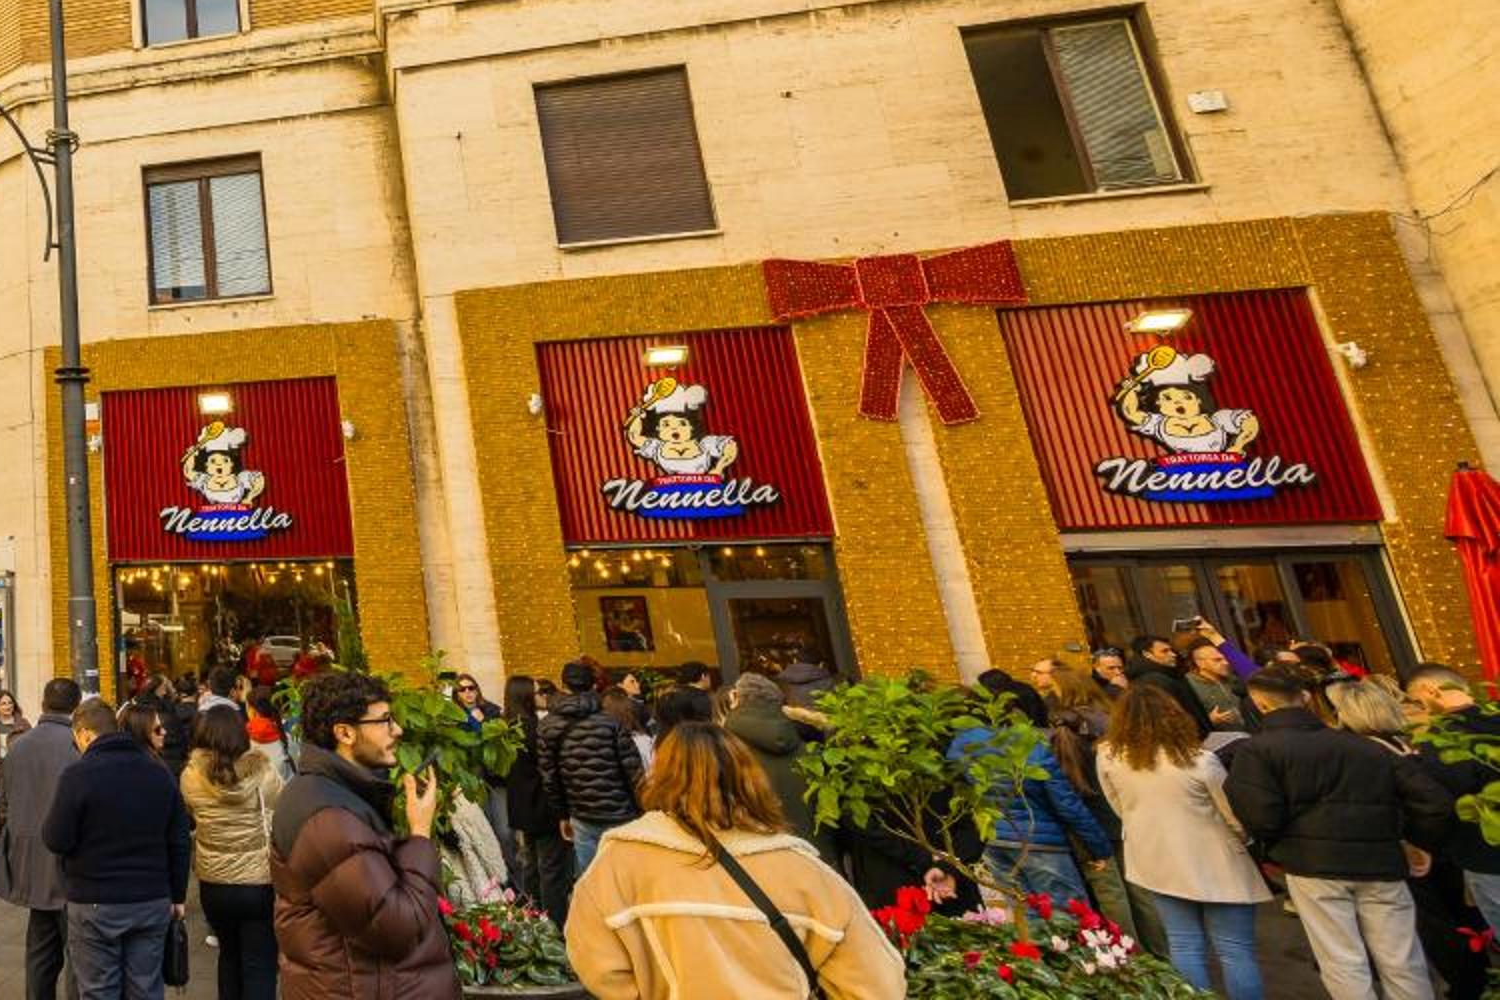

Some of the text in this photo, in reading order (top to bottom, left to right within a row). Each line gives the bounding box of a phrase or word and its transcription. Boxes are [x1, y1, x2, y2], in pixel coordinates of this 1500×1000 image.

[1097, 456, 1315, 492] Nennella
[603, 477, 779, 510] Nennella
[160, 506, 293, 532] Nennella
